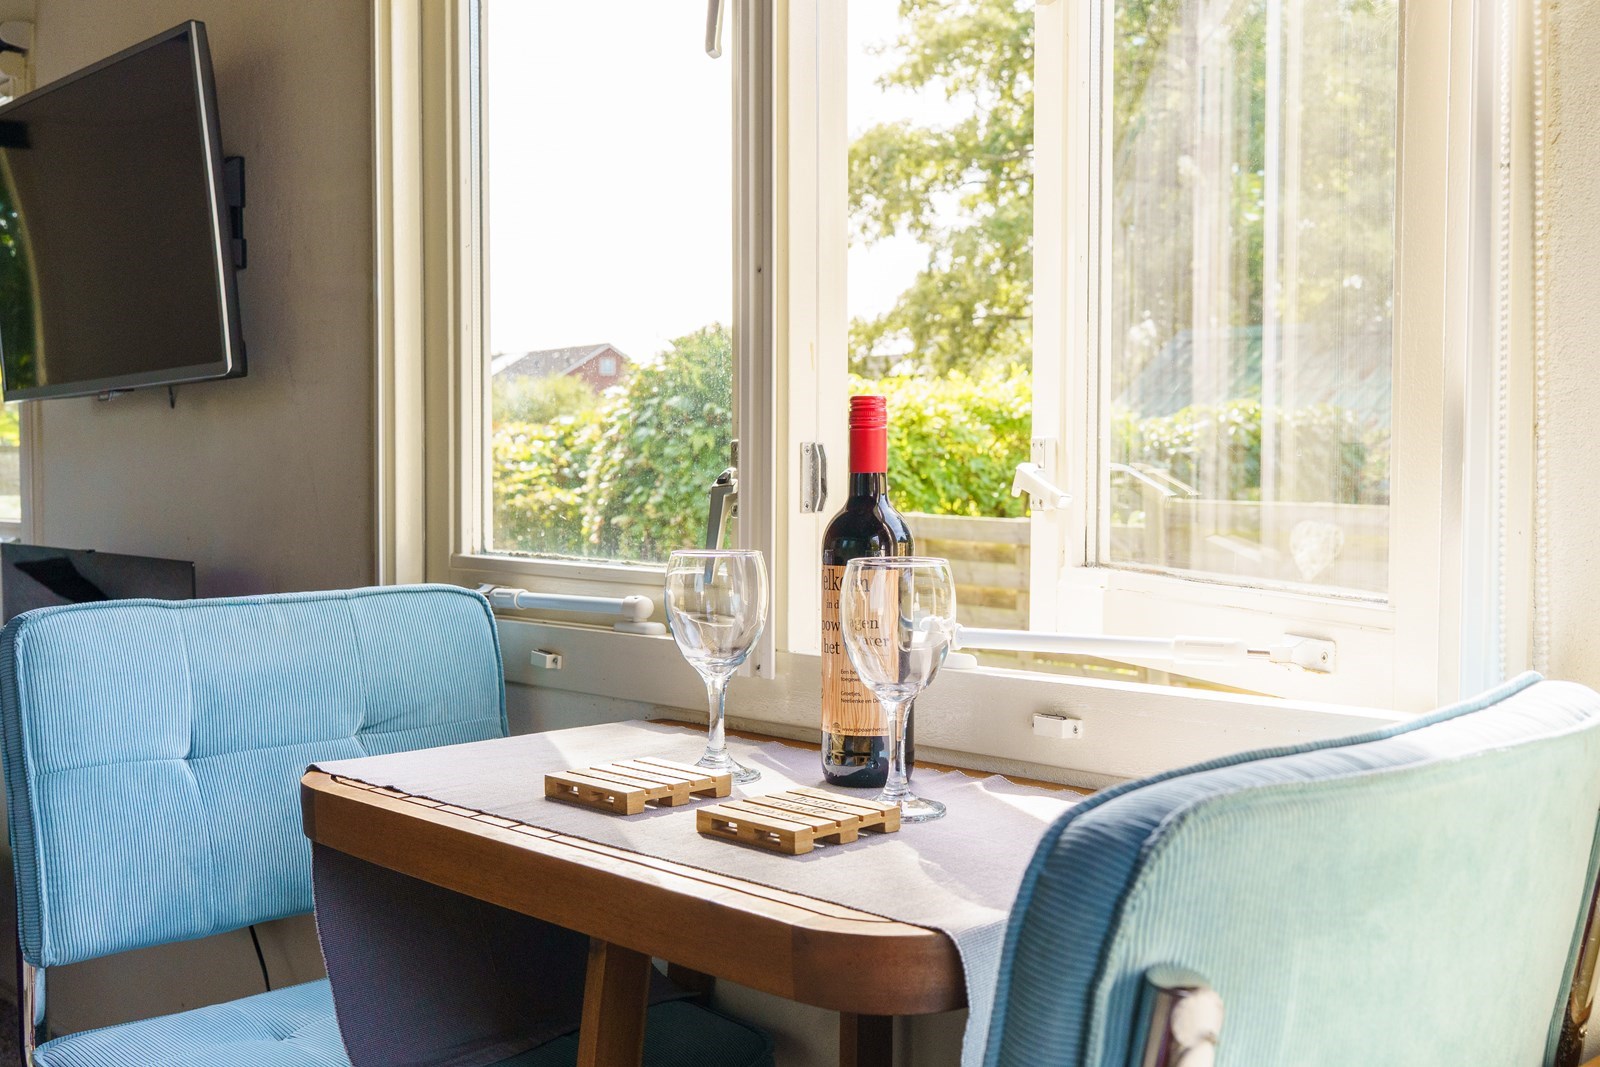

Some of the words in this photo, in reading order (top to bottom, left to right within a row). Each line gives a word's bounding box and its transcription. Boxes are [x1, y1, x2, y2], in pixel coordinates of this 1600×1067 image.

[826, 600, 832, 609] in
[824, 638, 840, 655] het
[840, 690, 861, 698] Groetjes,
